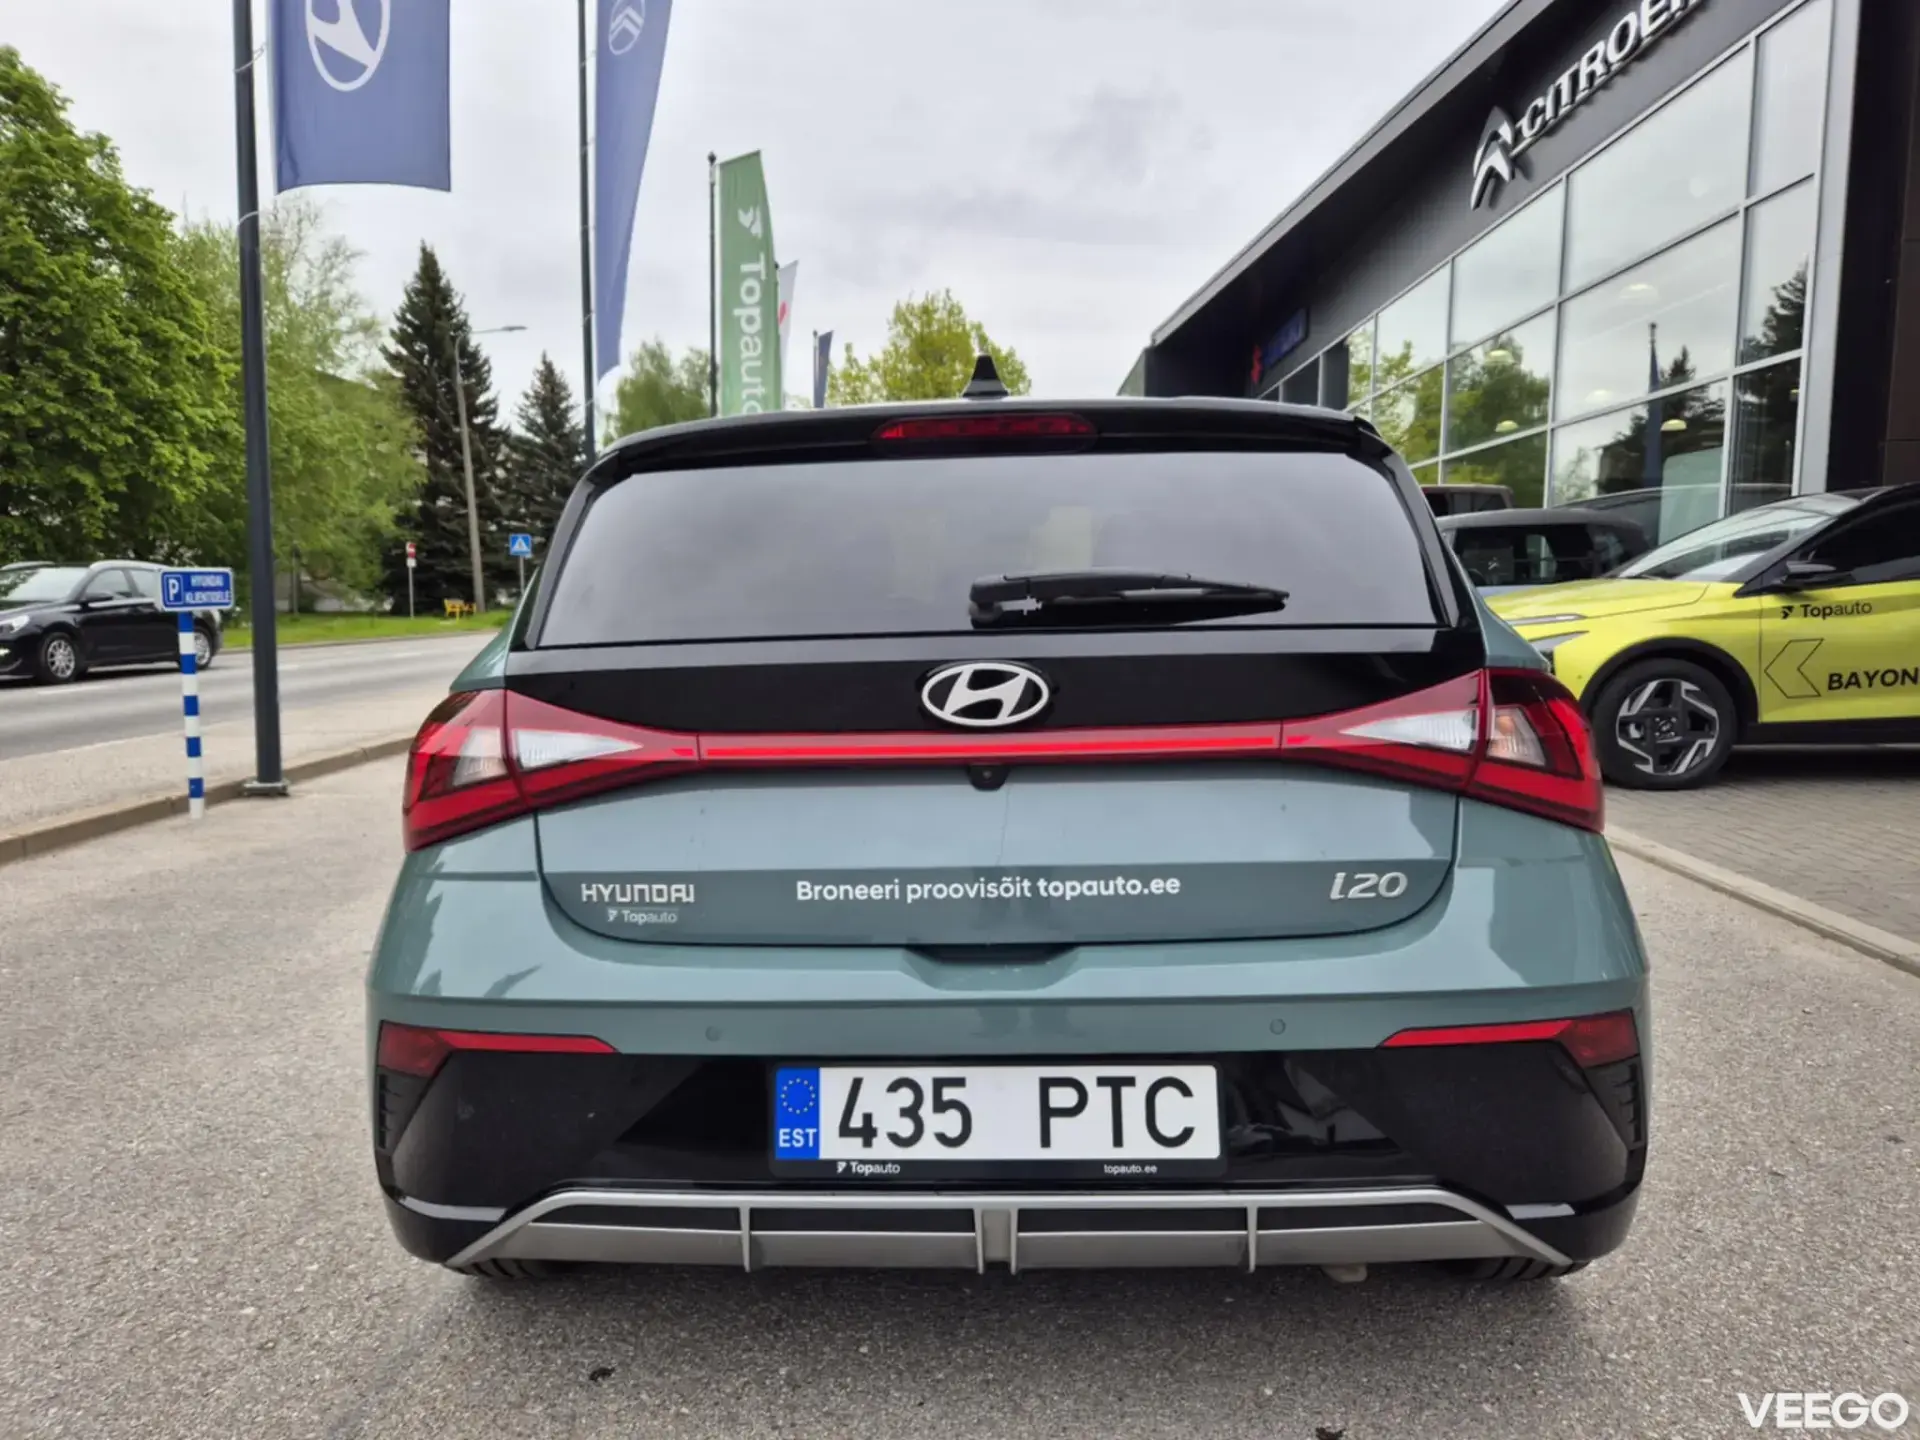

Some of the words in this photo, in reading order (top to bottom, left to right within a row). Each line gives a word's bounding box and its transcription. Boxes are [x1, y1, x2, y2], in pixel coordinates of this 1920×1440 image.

[1516, 0, 1699, 138] CITROE
[168, 578, 180, 601] P
[1800, 600, 1872, 620] Topauto
[1827, 667, 1919, 691] BAYON
[581, 883, 695, 903] HYUNDAI
[796, 879, 900, 901] Broneeri
[906, 876, 1032, 903] proovisõit
[1037, 876, 1181, 901] topauto.ee
[1330, 871, 1408, 900] i20
[621, 909, 678, 926] Topauto
[838, 1076, 972, 1149] 435
[1039, 1076, 1195, 1149] PTC
[778, 1128, 817, 1148] EST
[850, 1161, 901, 1175] Topauto
[1103, 1163, 1158, 1175] topauto.ee
